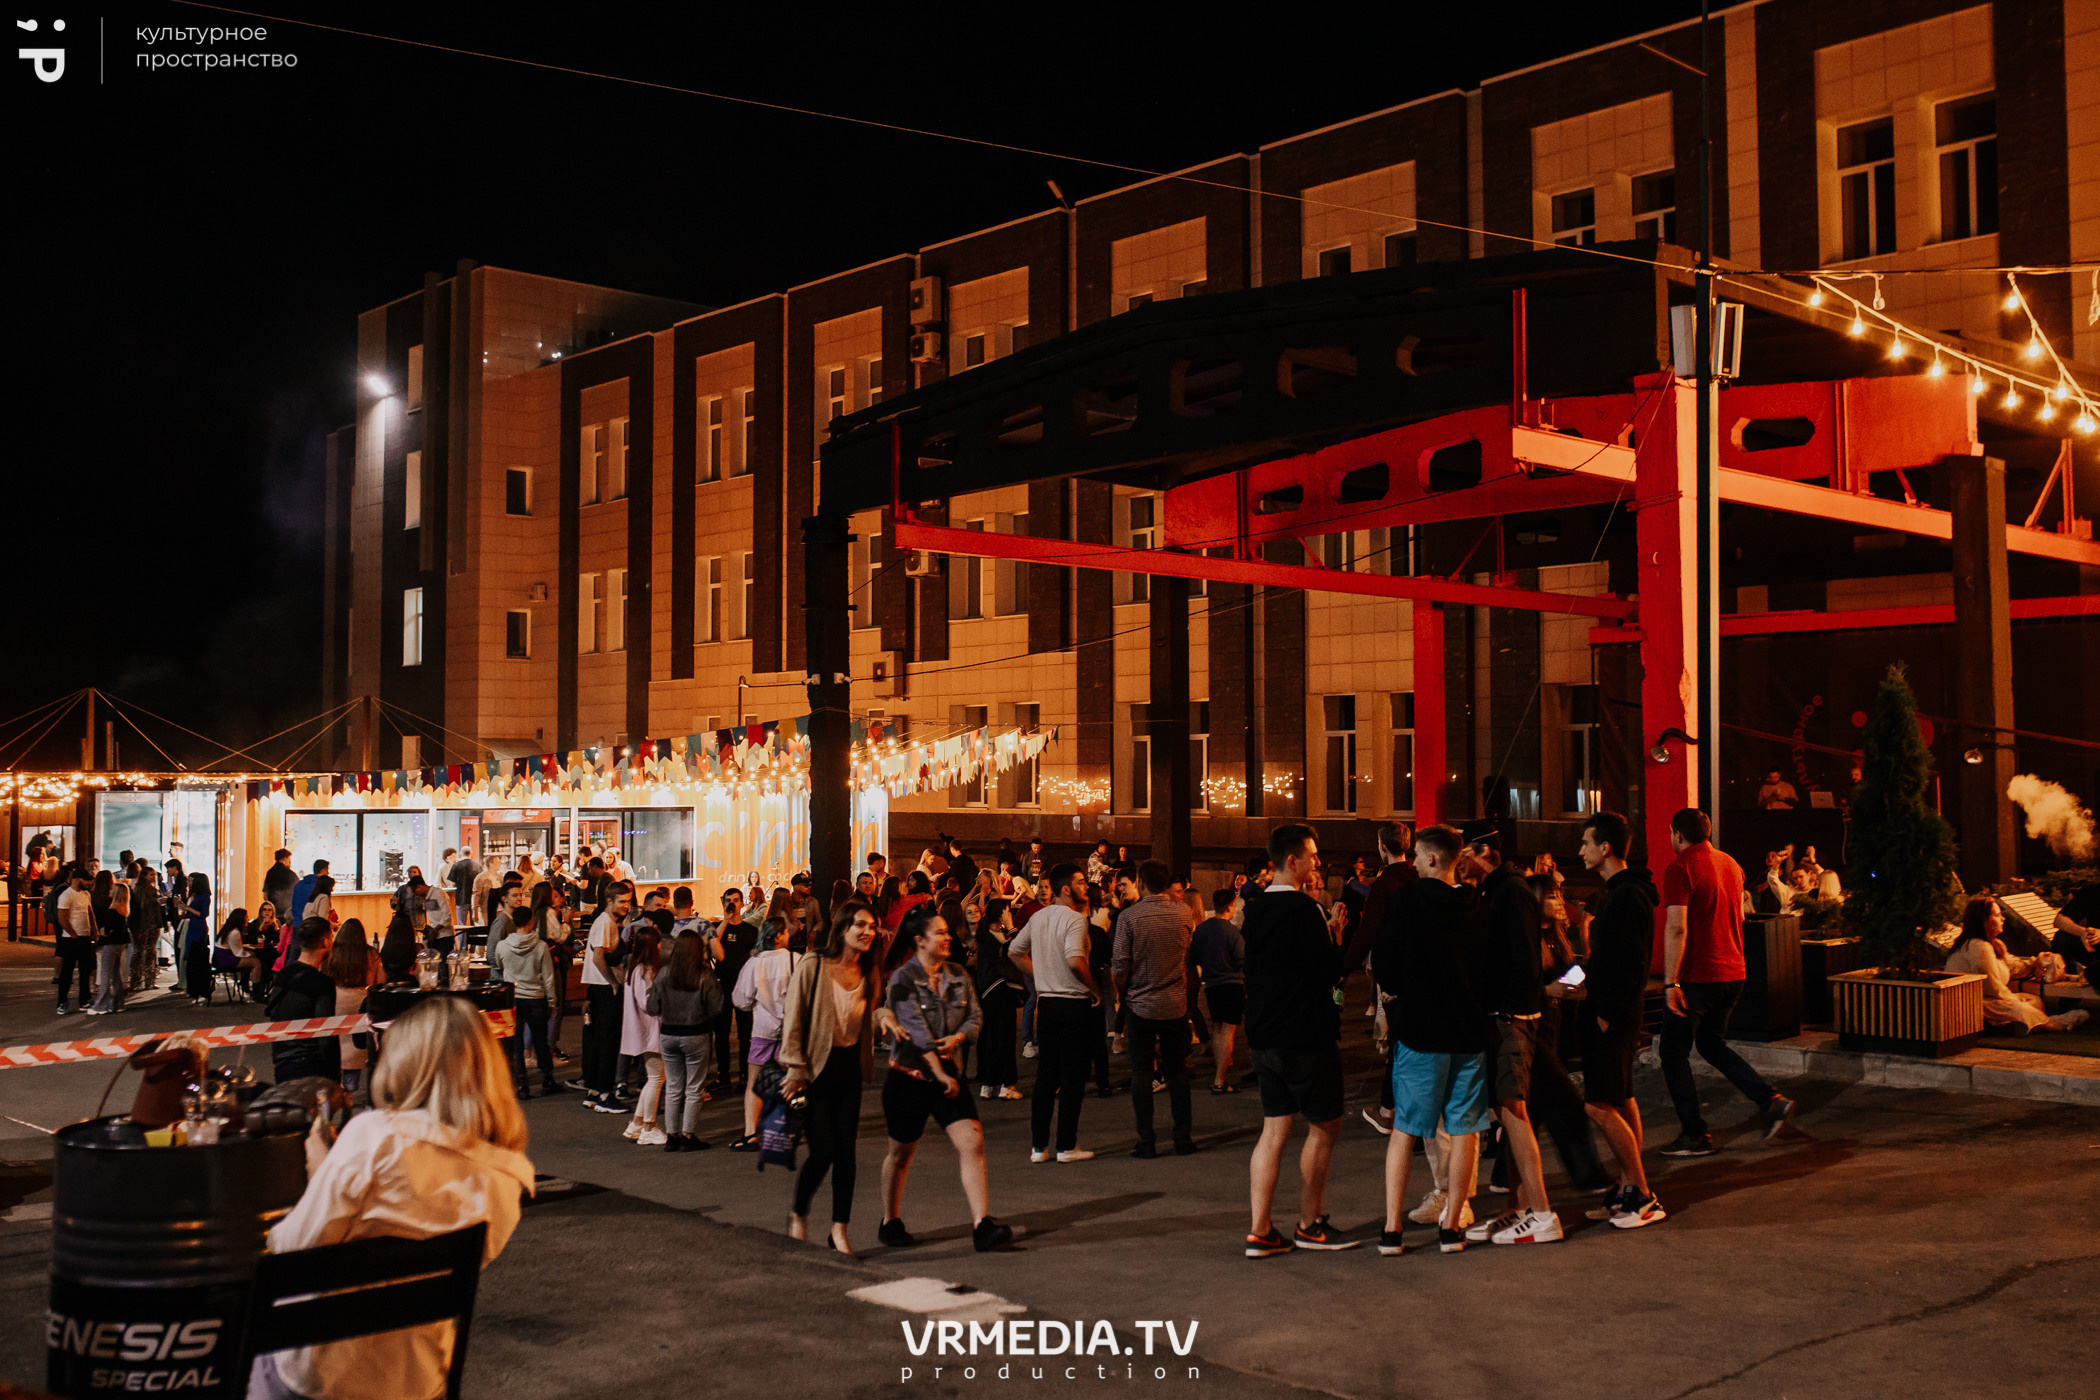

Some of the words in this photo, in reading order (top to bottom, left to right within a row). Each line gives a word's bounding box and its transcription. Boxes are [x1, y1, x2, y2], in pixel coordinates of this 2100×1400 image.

[1792, 695, 1824, 792] ультурное
[46, 1310, 222, 1361] ENESIS
[91, 1366, 221, 1392] SPECIAL
